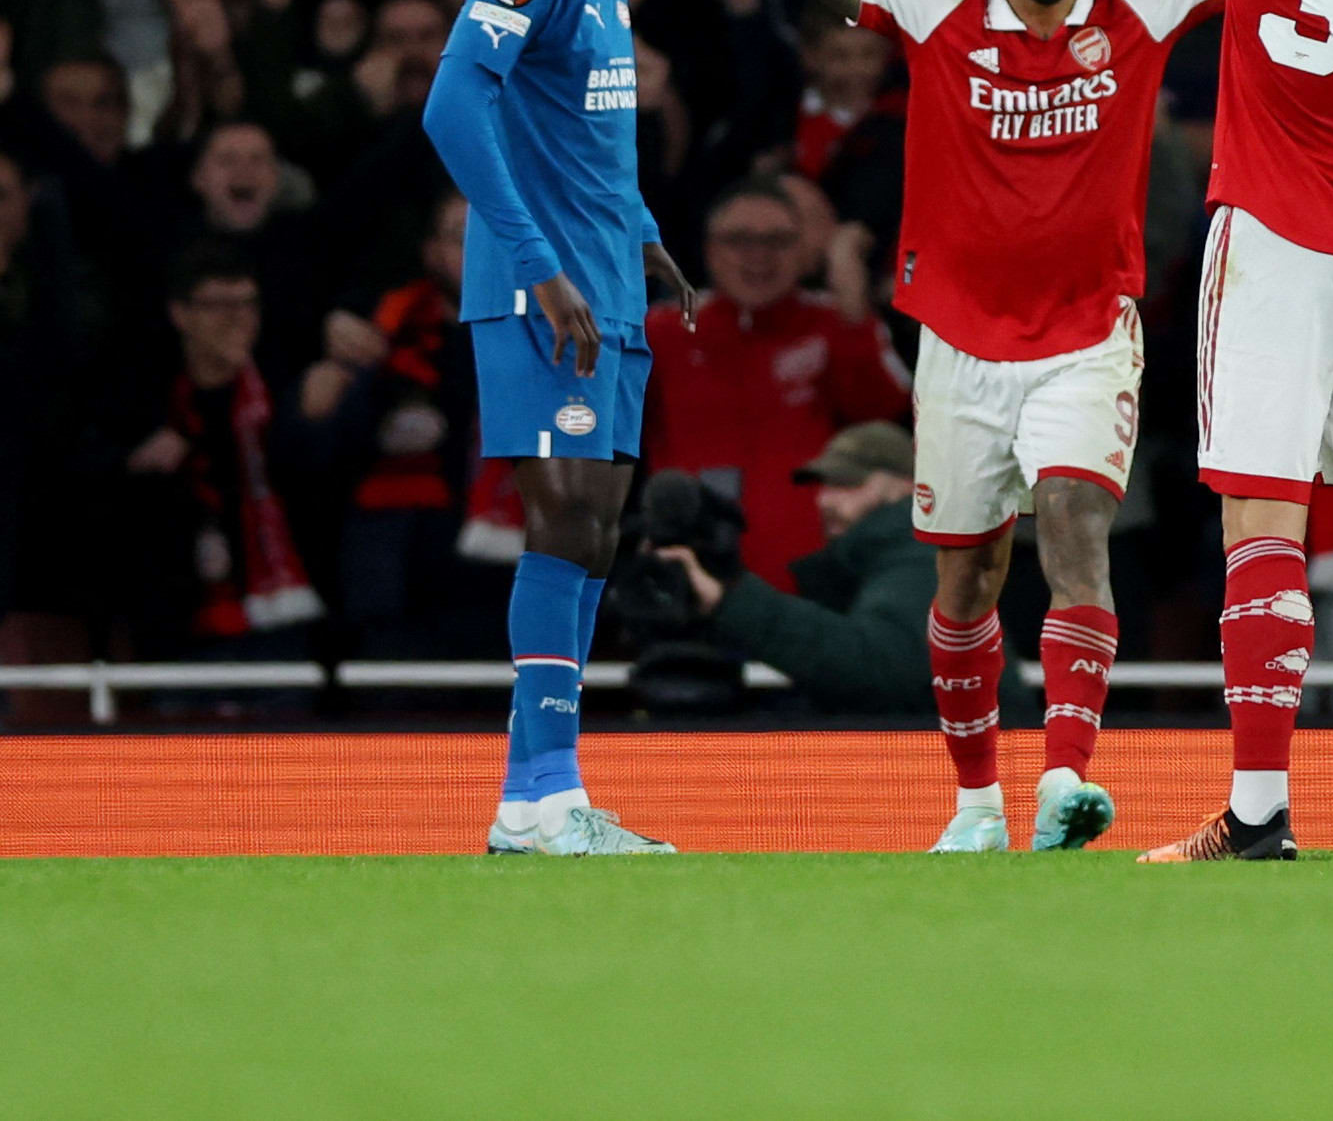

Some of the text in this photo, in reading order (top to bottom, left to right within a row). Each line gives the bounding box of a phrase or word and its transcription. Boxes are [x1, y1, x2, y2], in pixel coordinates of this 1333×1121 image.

[968, 69, 1118, 113] Emirates
[990, 103, 1099, 140] FLY BETTER
[1114, 391, 1140, 448] 9
[931, 675, 982, 691] AFC
[539, 696, 578, 714] PSV
